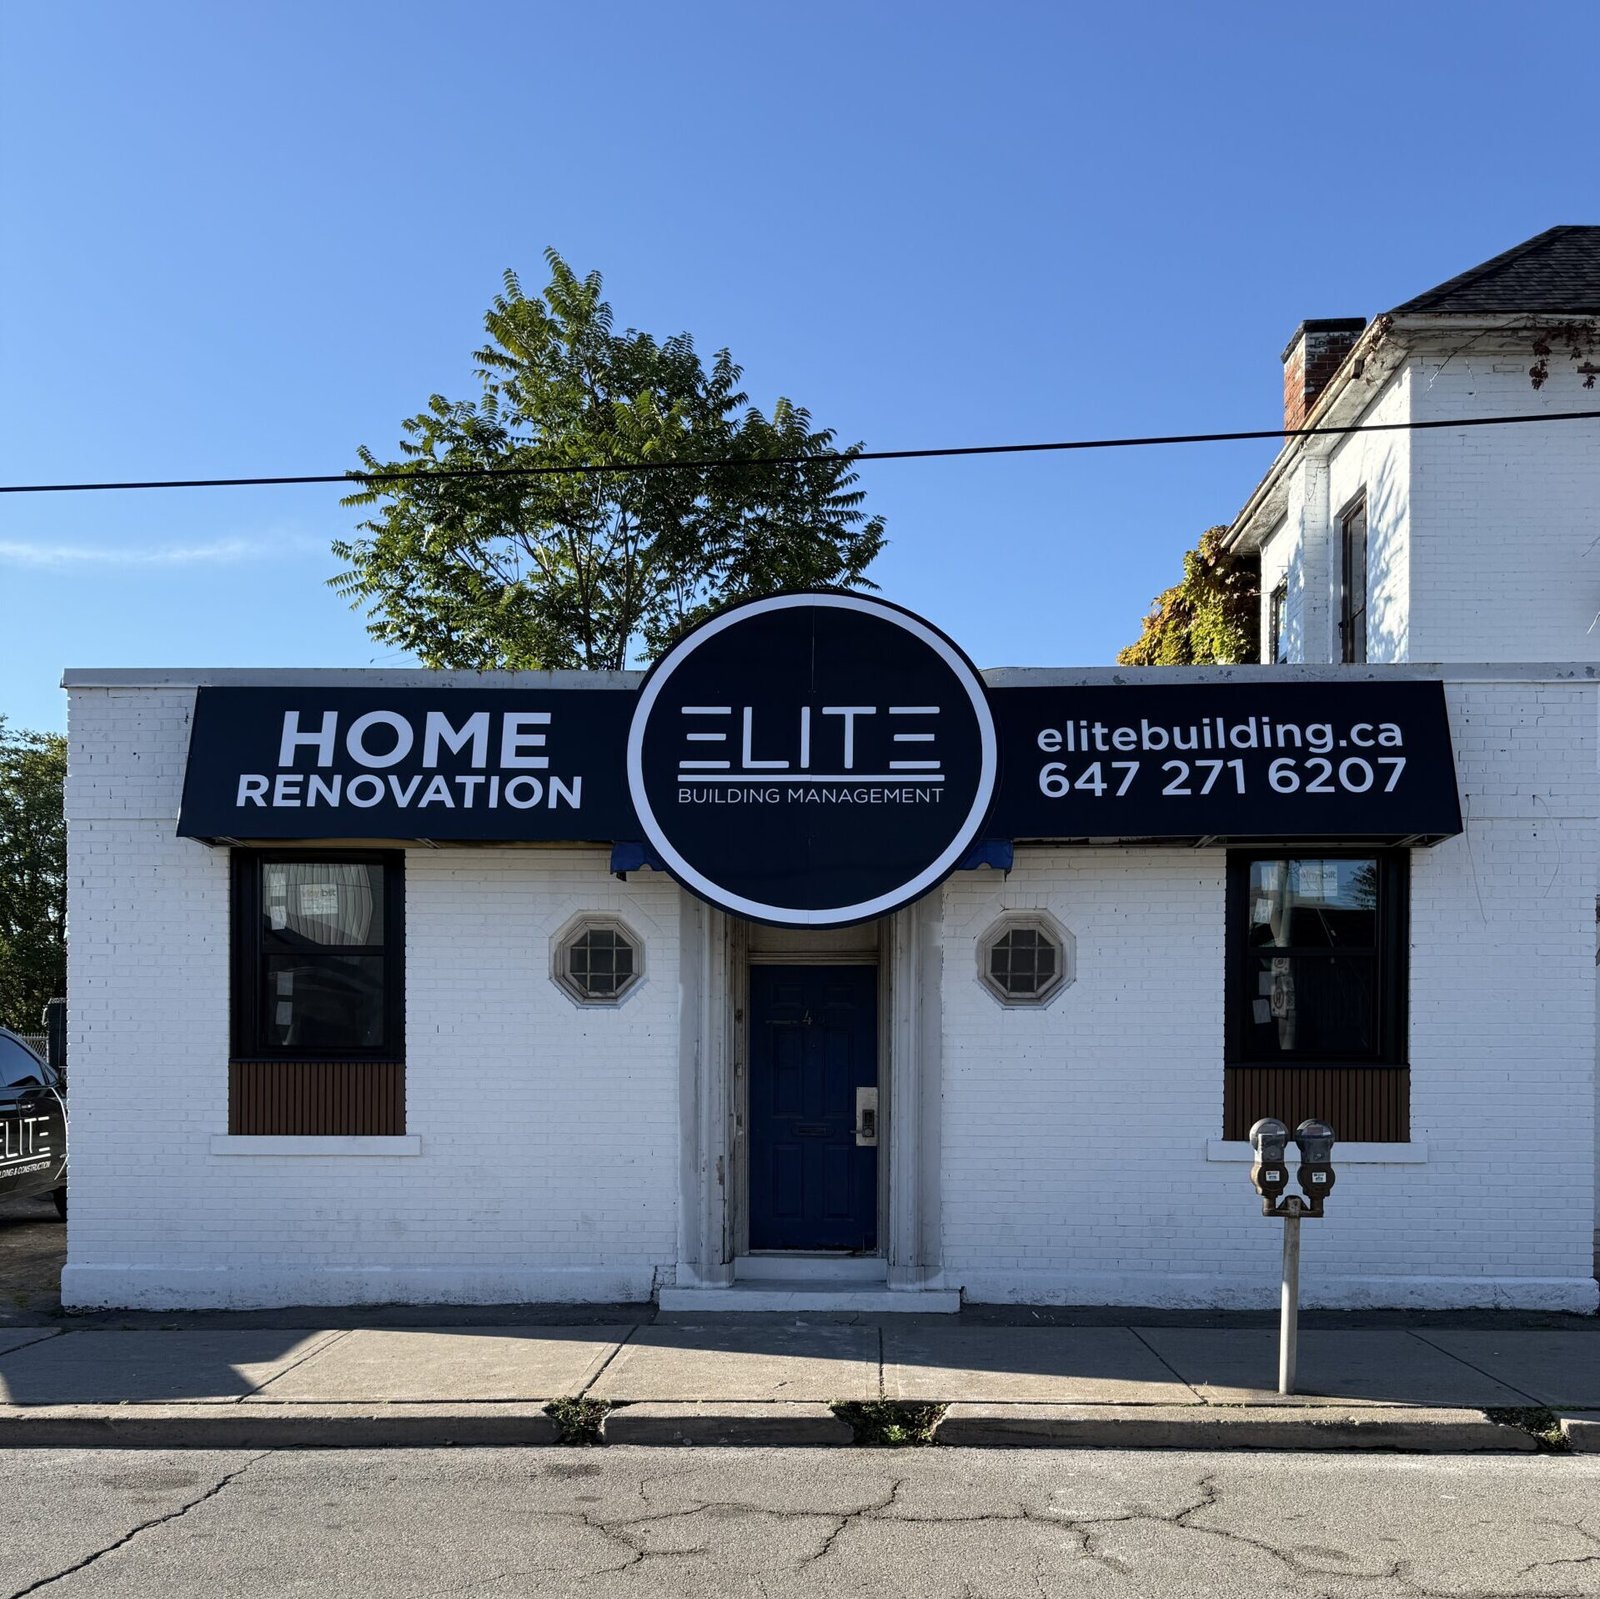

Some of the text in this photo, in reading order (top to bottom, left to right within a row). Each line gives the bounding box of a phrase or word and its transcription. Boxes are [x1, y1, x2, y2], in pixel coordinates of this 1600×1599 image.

[278, 710, 552, 769] HOME
[680, 706, 941, 769] ELITE
[1037, 716, 1404, 754] elitebuilding.ca
[236, 774, 582, 809] RENOVATION
[678, 788, 944, 803] BUILDING MANAGEMENT
[1038, 756, 1407, 798] 647 271 6207
